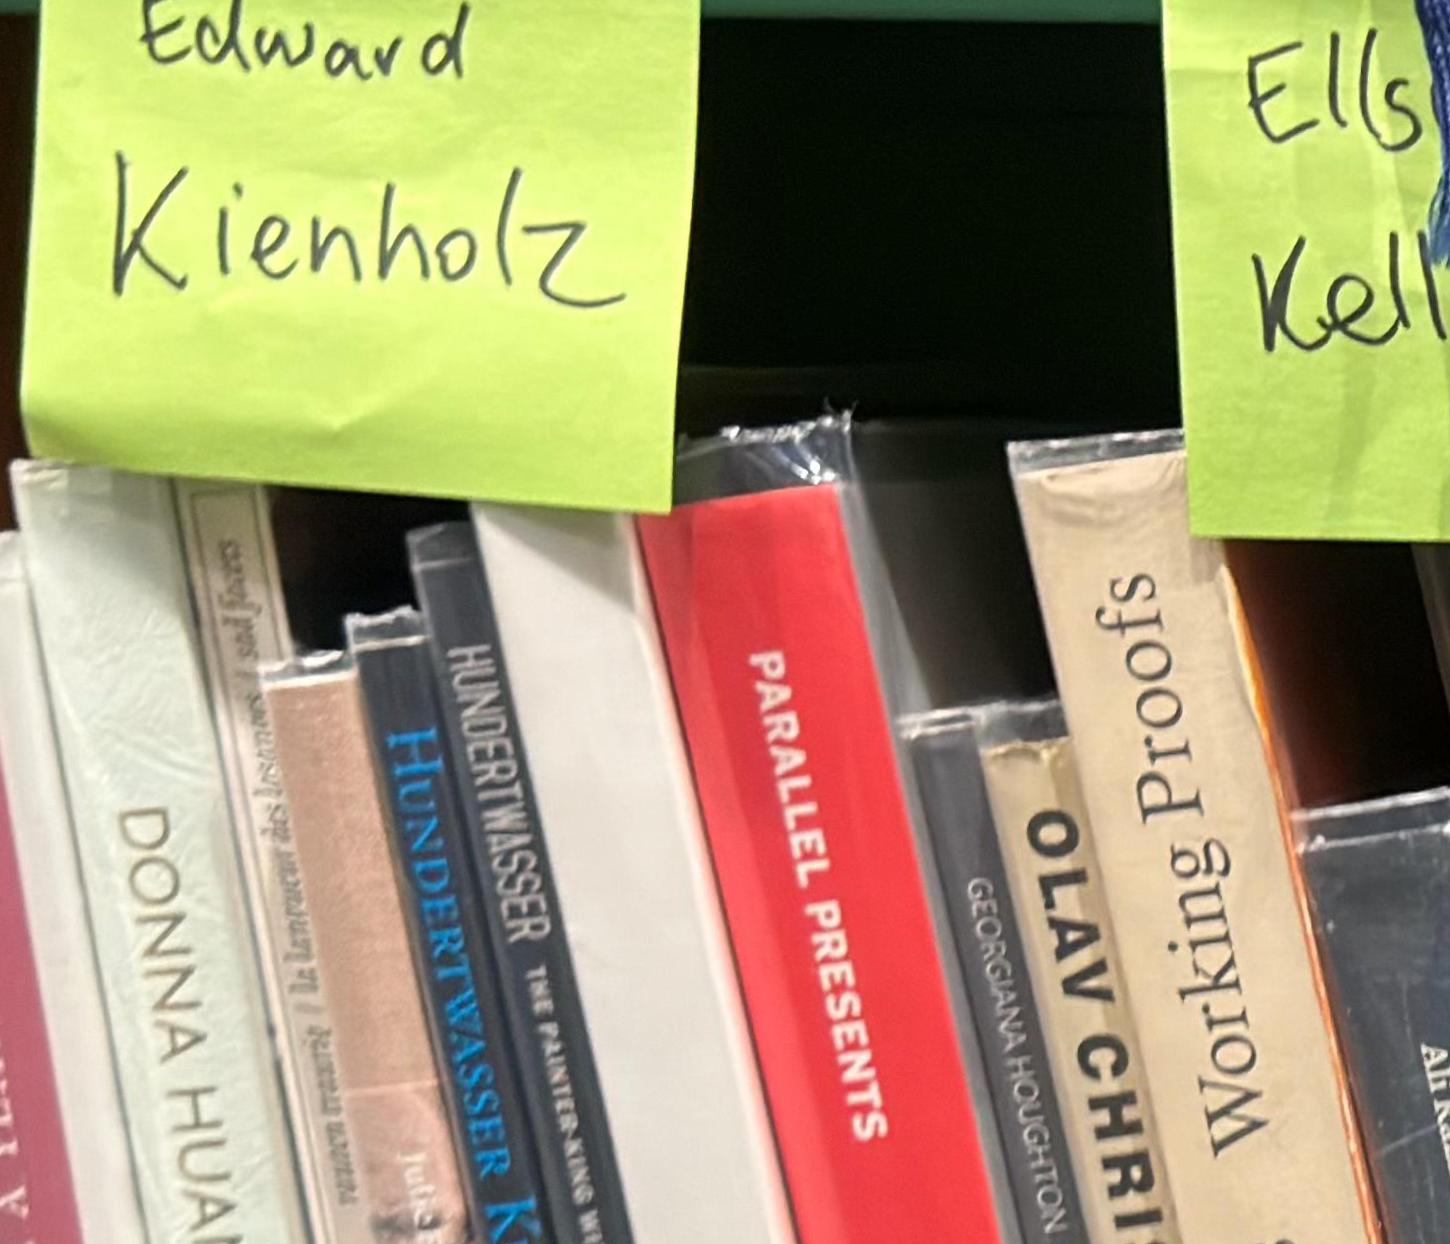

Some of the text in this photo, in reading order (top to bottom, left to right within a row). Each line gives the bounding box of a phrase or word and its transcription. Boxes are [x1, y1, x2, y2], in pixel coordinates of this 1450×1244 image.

[140, 0, 470, 80] Edward
[113, 150, 628, 309] Kienholz
[445, 643, 553, 945] HUNDERTWASSER
[1093, 571, 1206, 826] Proofs
[116, 805, 210, 1065] DONNA
[384, 724, 513, 1180] HUNDERTWASSER
[524, 964, 555, 1014] THE
[748, 649, 889, 1142] PARALLEL PRESENTS
[1025, 807, 1115, 1005] OLAV
[1166, 836, 1271, 1159] Working
[537, 1020, 595, 1206] PAINTER-KING
[964, 876, 1028, 1053] GEORGIANA
[1003, 1054, 1069, 1235] HOUGHTON
[396, 1151, 440, 1235] Julie
